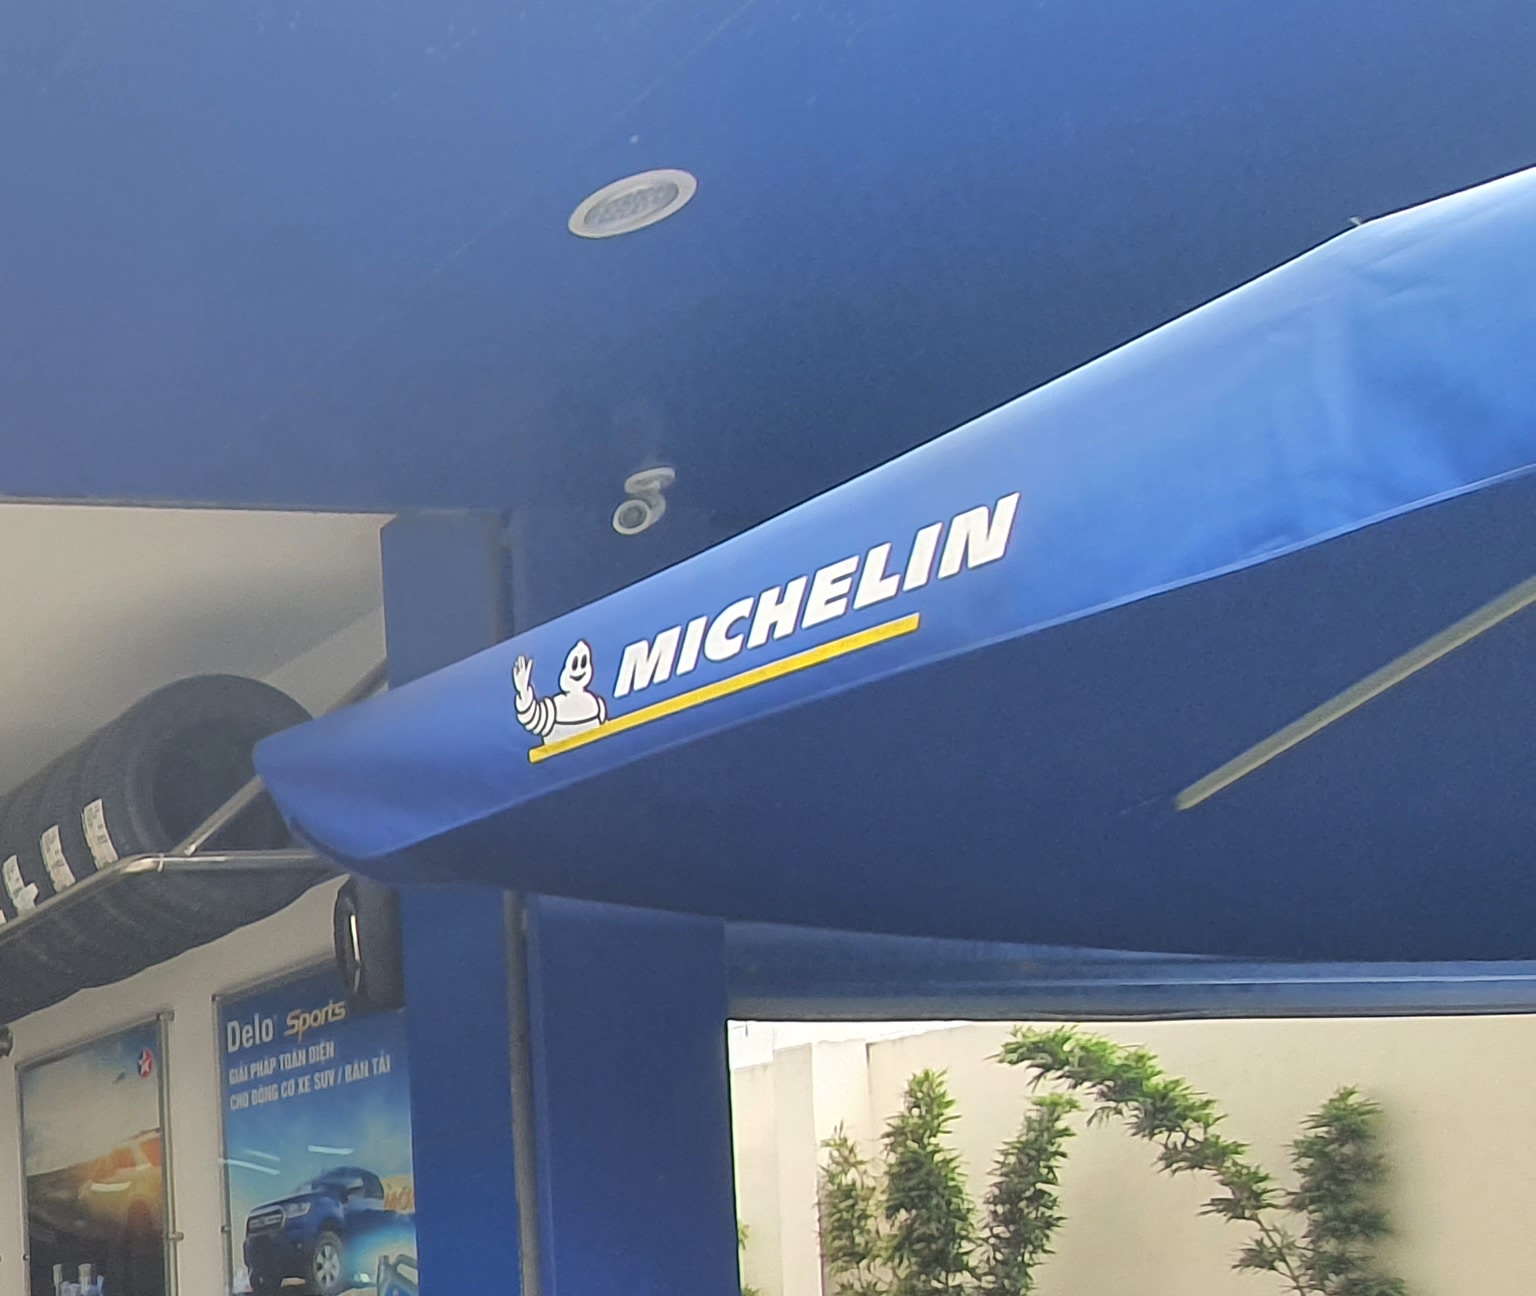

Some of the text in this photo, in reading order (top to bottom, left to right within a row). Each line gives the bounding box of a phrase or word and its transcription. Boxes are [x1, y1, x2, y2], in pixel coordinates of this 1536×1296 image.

[613, 491, 1021, 698] MICHELIN
[227, 1000, 347, 1053] Delo Sports
[297, 1076, 311, 1094] XE
[314, 1070, 335, 1090] SUV
